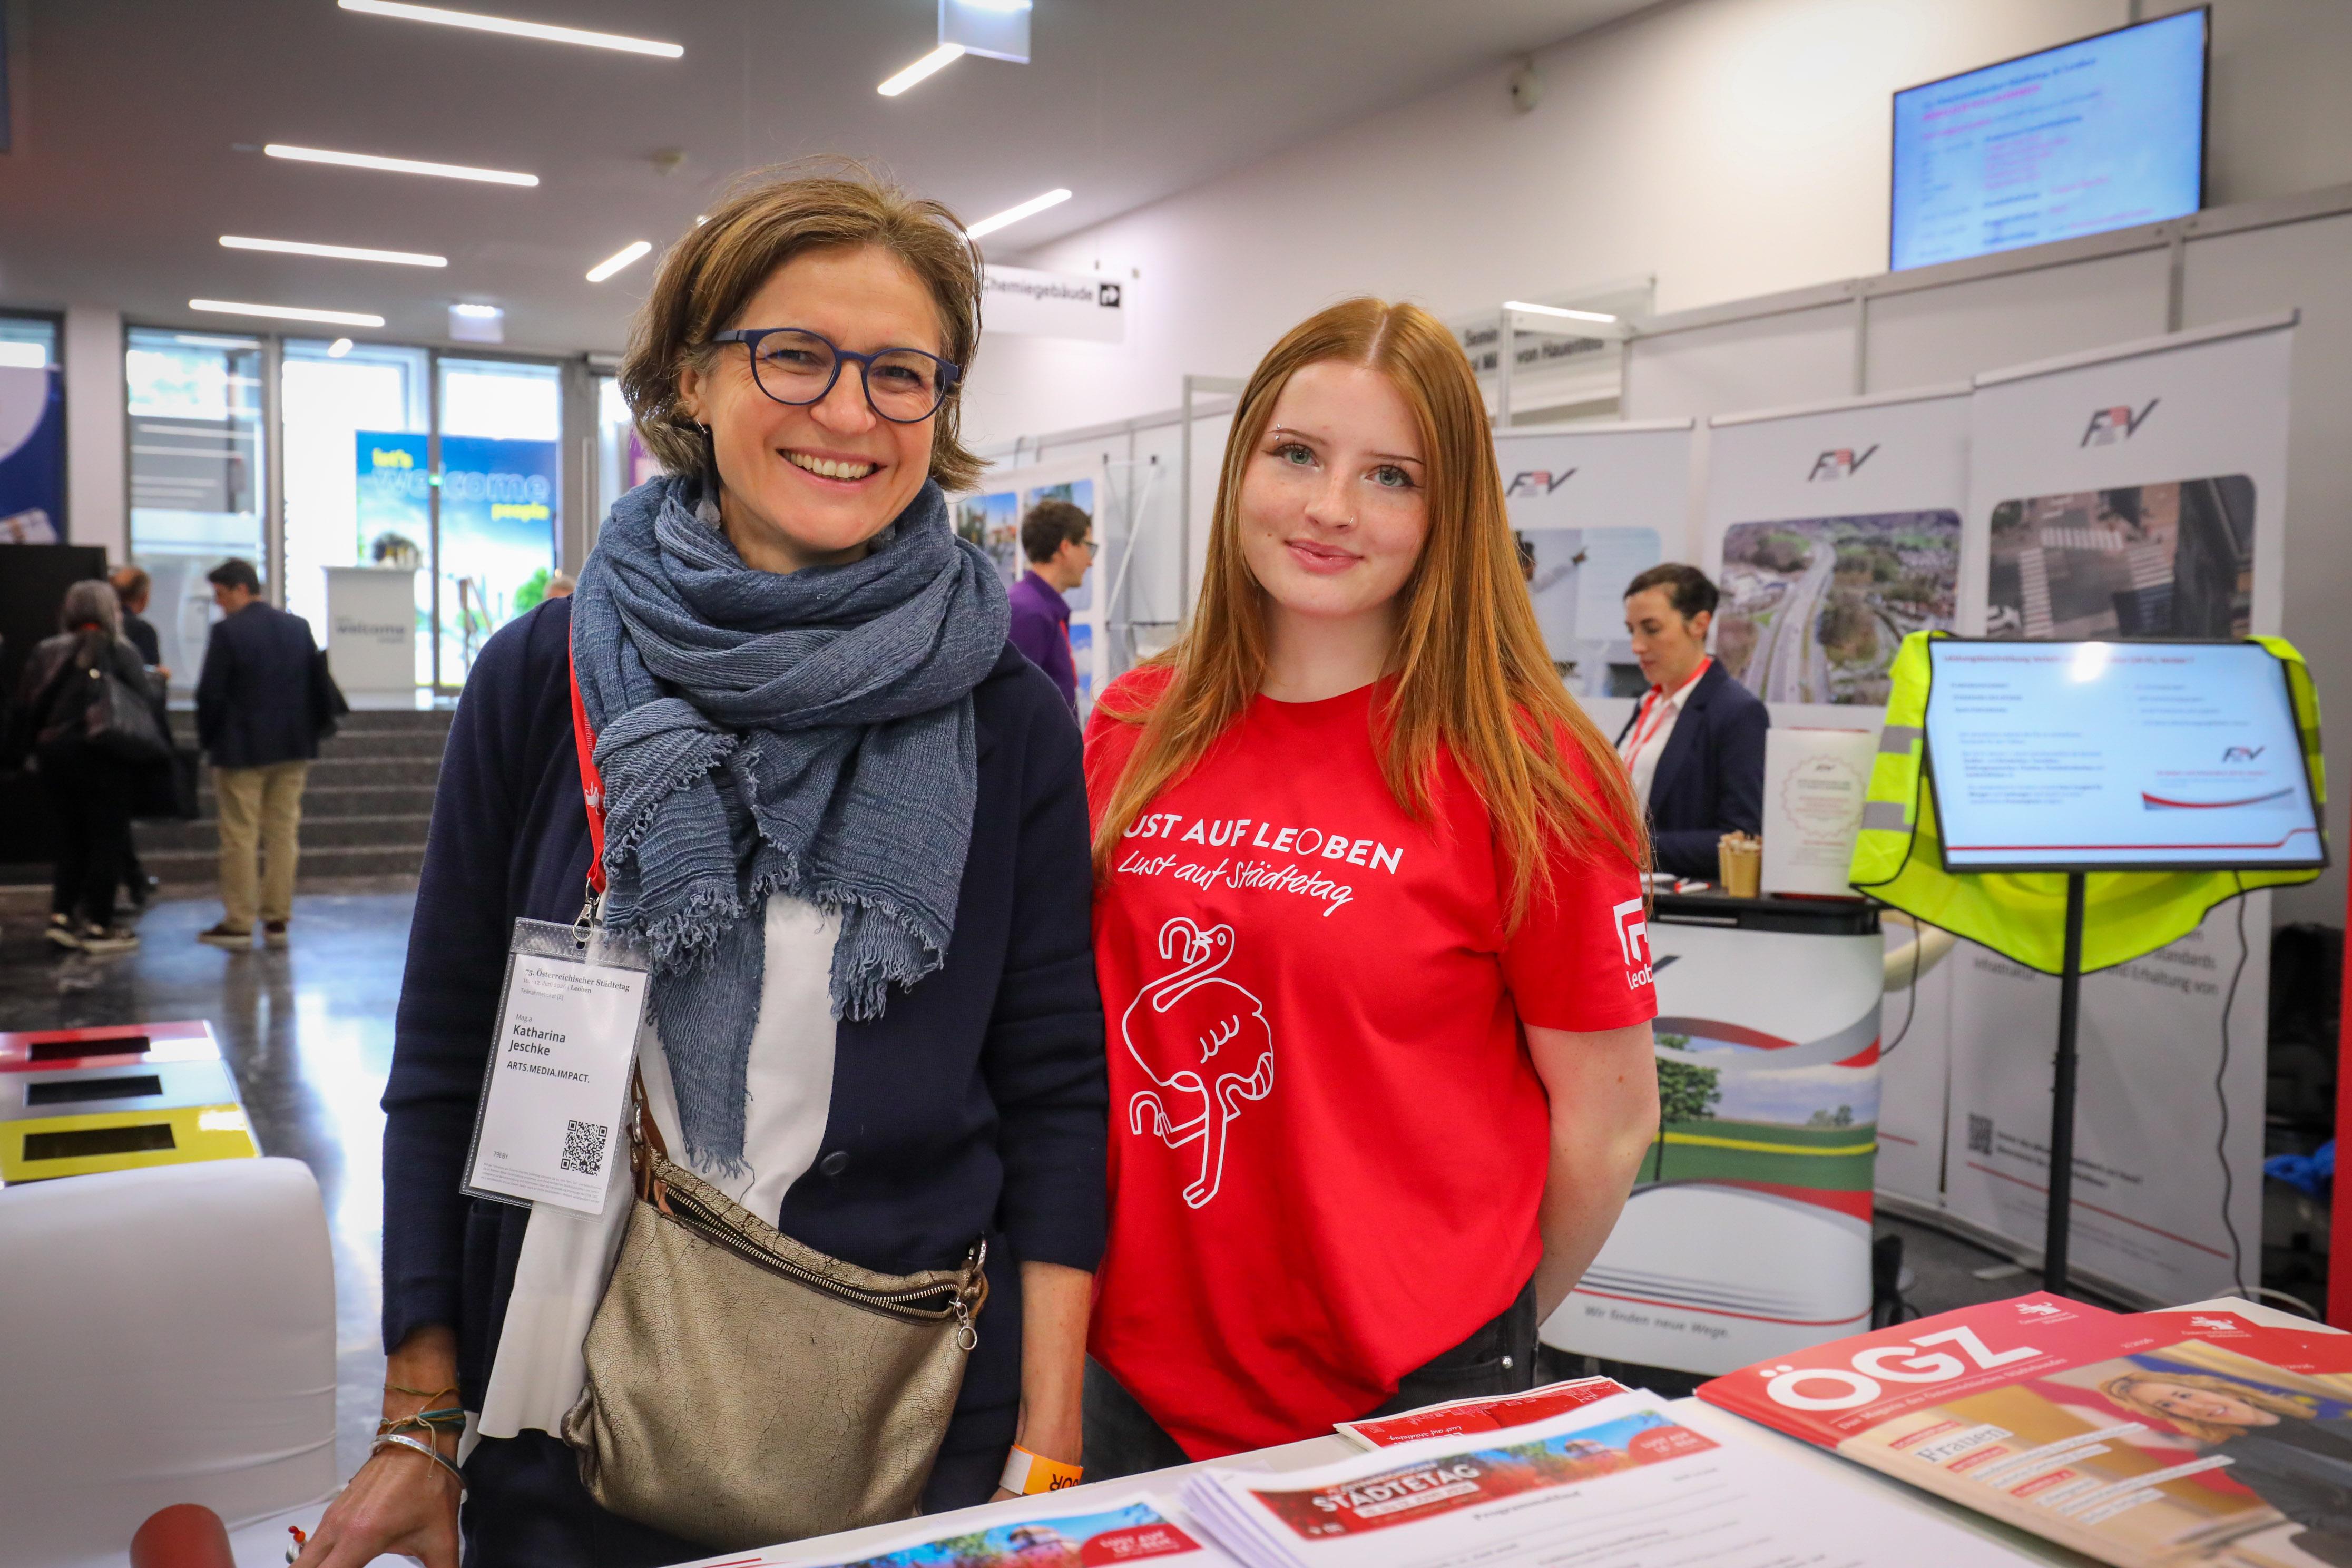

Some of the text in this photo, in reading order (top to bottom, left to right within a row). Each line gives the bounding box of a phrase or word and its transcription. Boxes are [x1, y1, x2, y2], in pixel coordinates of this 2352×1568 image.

[1123, 814, 1404, 875] UST AUF LEOBEN
[1117, 850, 1354, 917] Lust auf Städtetag
[536, 967, 595, 985] Österreichischer
[595, 978, 630, 992] Städtetag
[571, 985, 591, 994] Leoben
[513, 1024, 566, 1043] Katharina
[508, 1039, 550, 1056] Jeschke
[507, 1061, 590, 1083] ARTS.MEDIA.IMPACT.
[1654, 1319, 1685, 1332] neue
[1760, 1325, 2043, 1411] ÖGZ
[1916, 1429, 2007, 1463] Frauen
